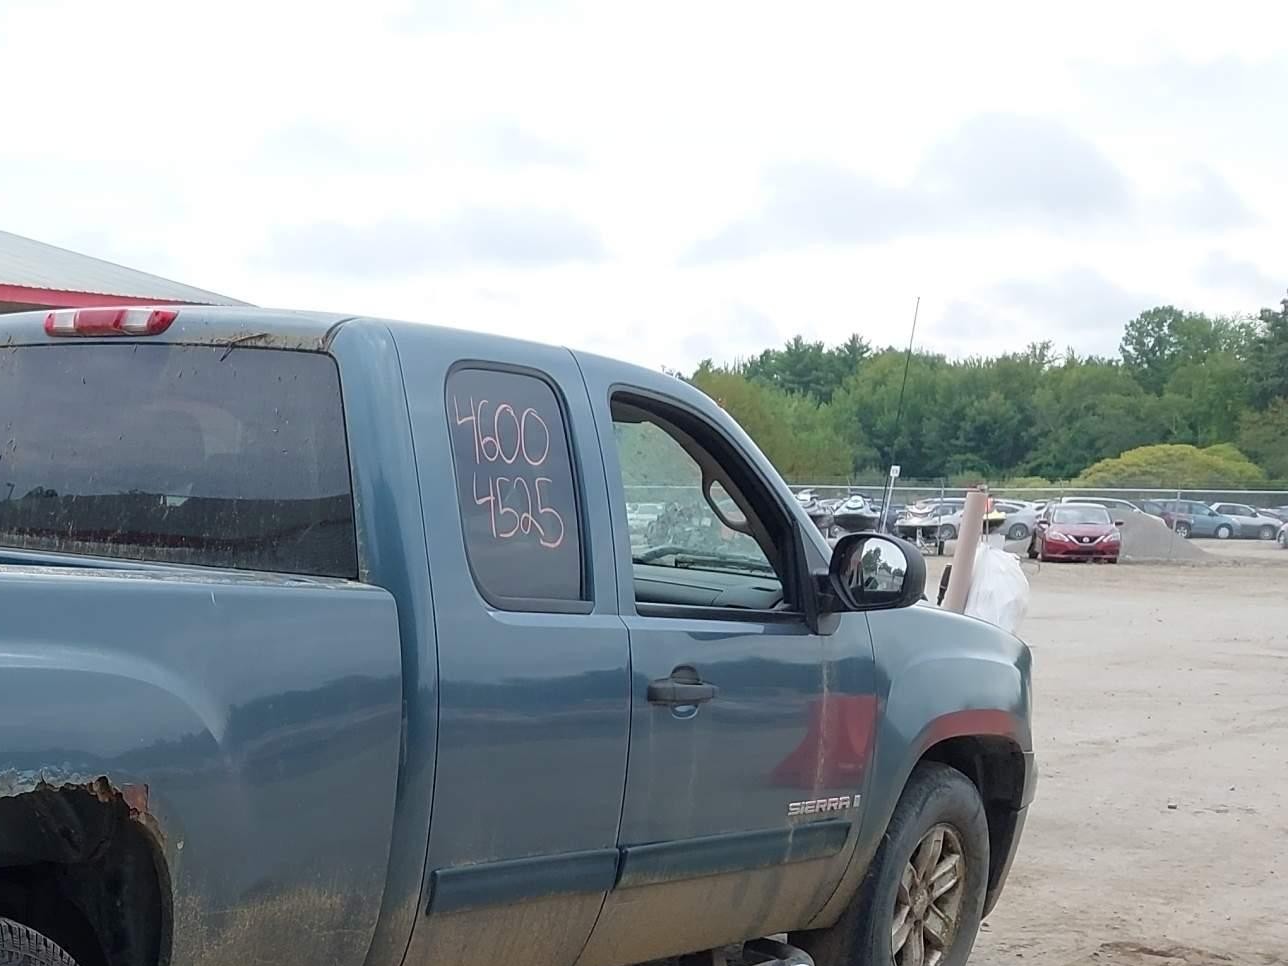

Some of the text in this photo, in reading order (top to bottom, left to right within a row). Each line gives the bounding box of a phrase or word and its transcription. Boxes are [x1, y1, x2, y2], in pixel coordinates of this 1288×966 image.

[453, 394, 550, 466] 4600
[472, 471, 564, 548] 4525
[788, 796, 850, 816] SIERRA
